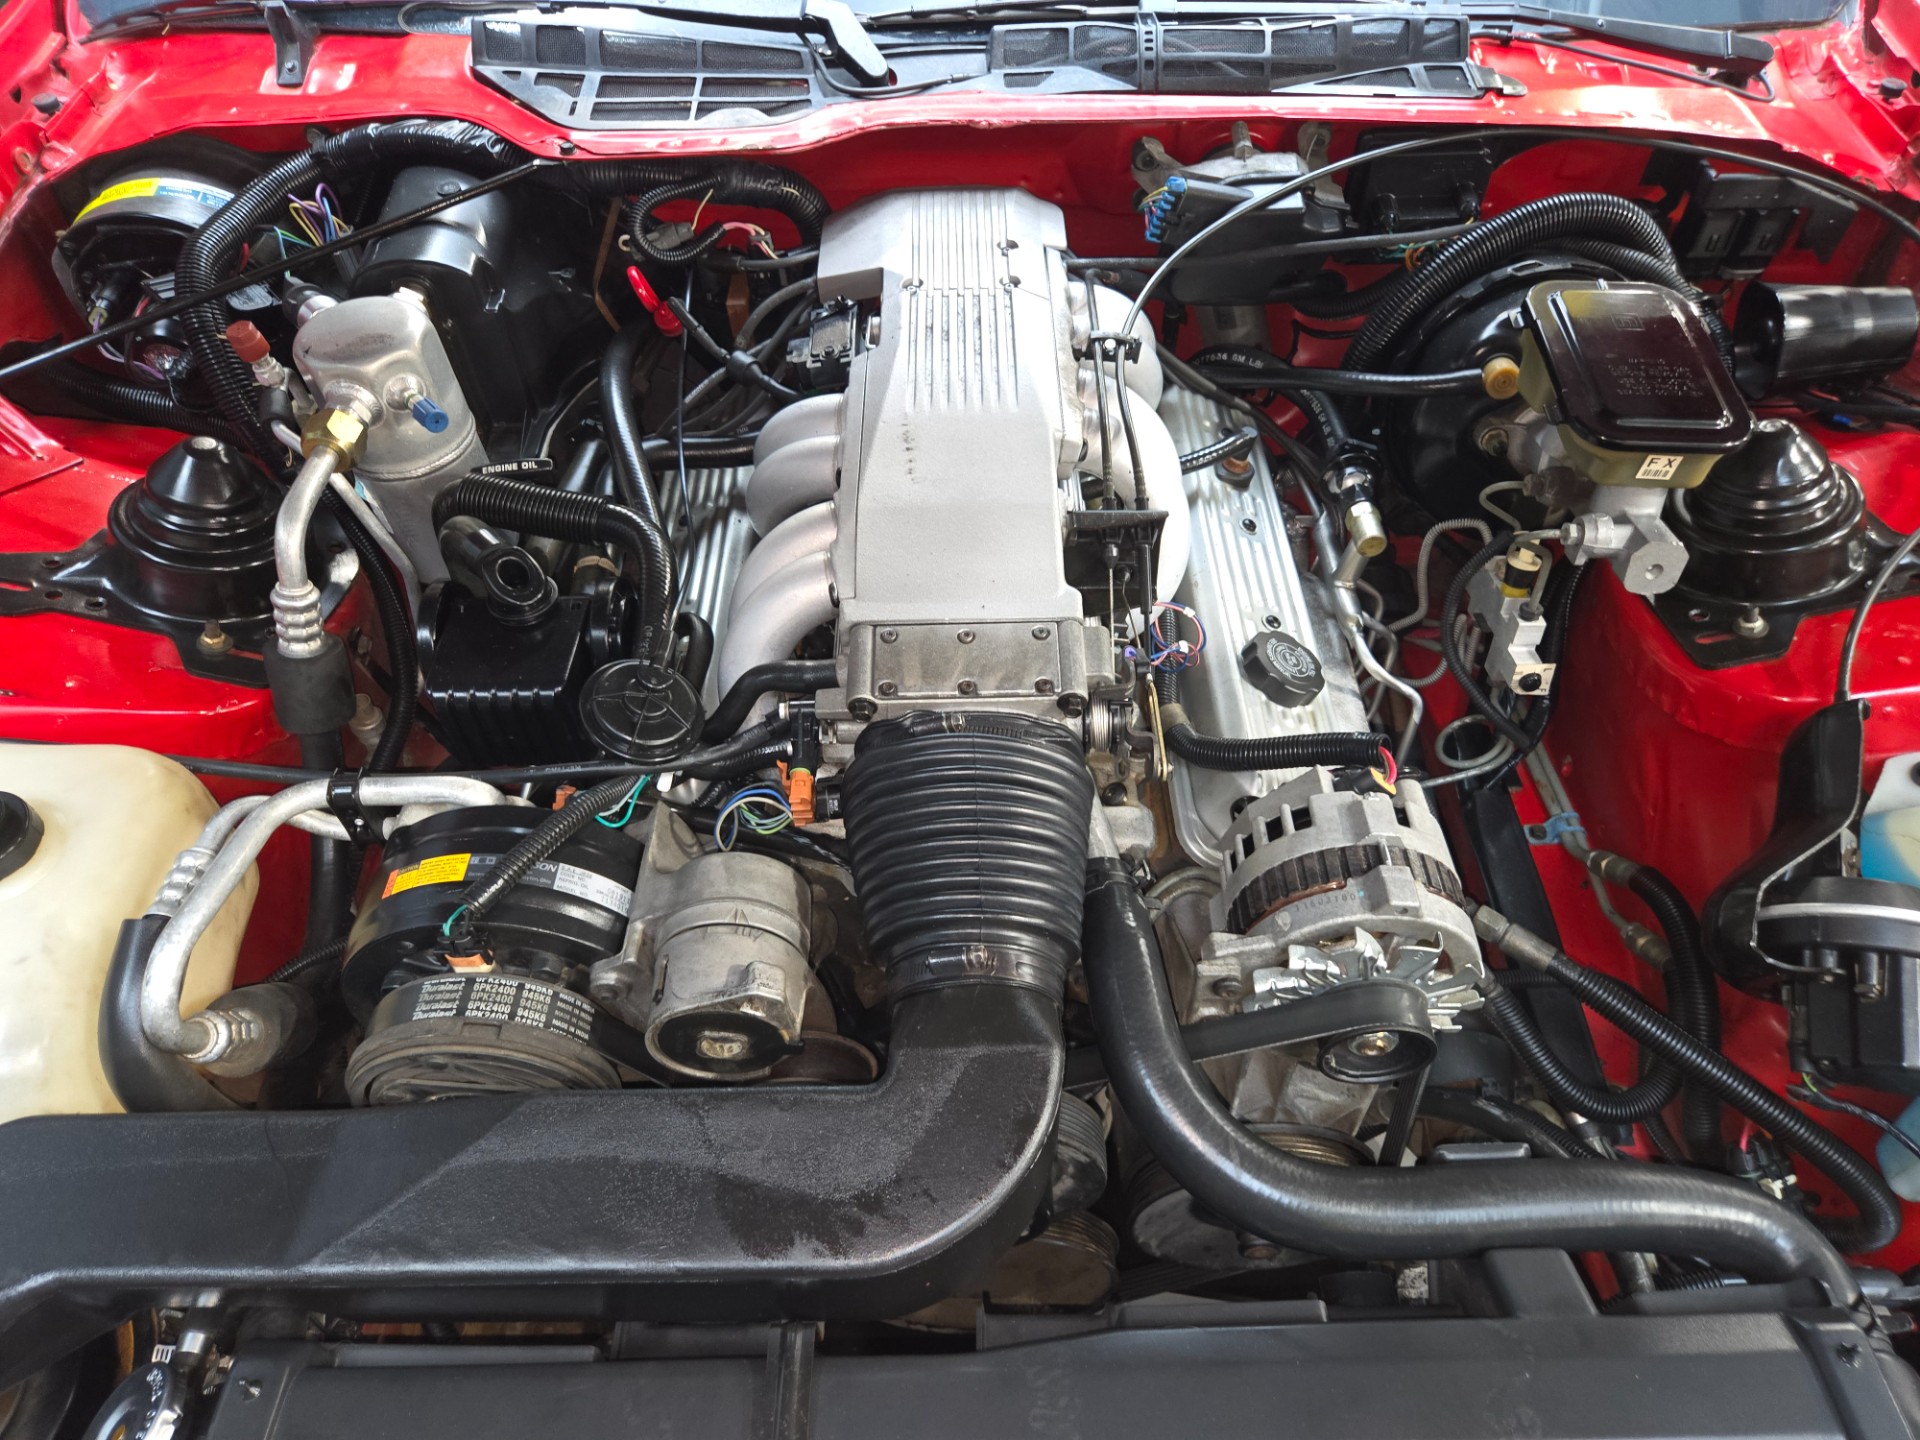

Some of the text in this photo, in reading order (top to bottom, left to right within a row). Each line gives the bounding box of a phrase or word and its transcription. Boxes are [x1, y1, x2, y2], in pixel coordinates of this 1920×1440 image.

[482, 461, 538, 474] ENGINE OIL
[418, 991, 462, 1002] Duralast
[470, 992, 514, 1004] 6PK2400
[519, 998, 549, 1013] 945K6
[421, 982, 465, 993] Duralast
[473, 983, 516, 995] 6PK2400
[522, 990, 551, 1004] 945K6
[412, 1009, 456, 1021] Duralast
[415, 1000, 459, 1011] Duralast
[467, 1001, 511, 1014] 6PK2400
[516, 1008, 546, 1022] 945K6
